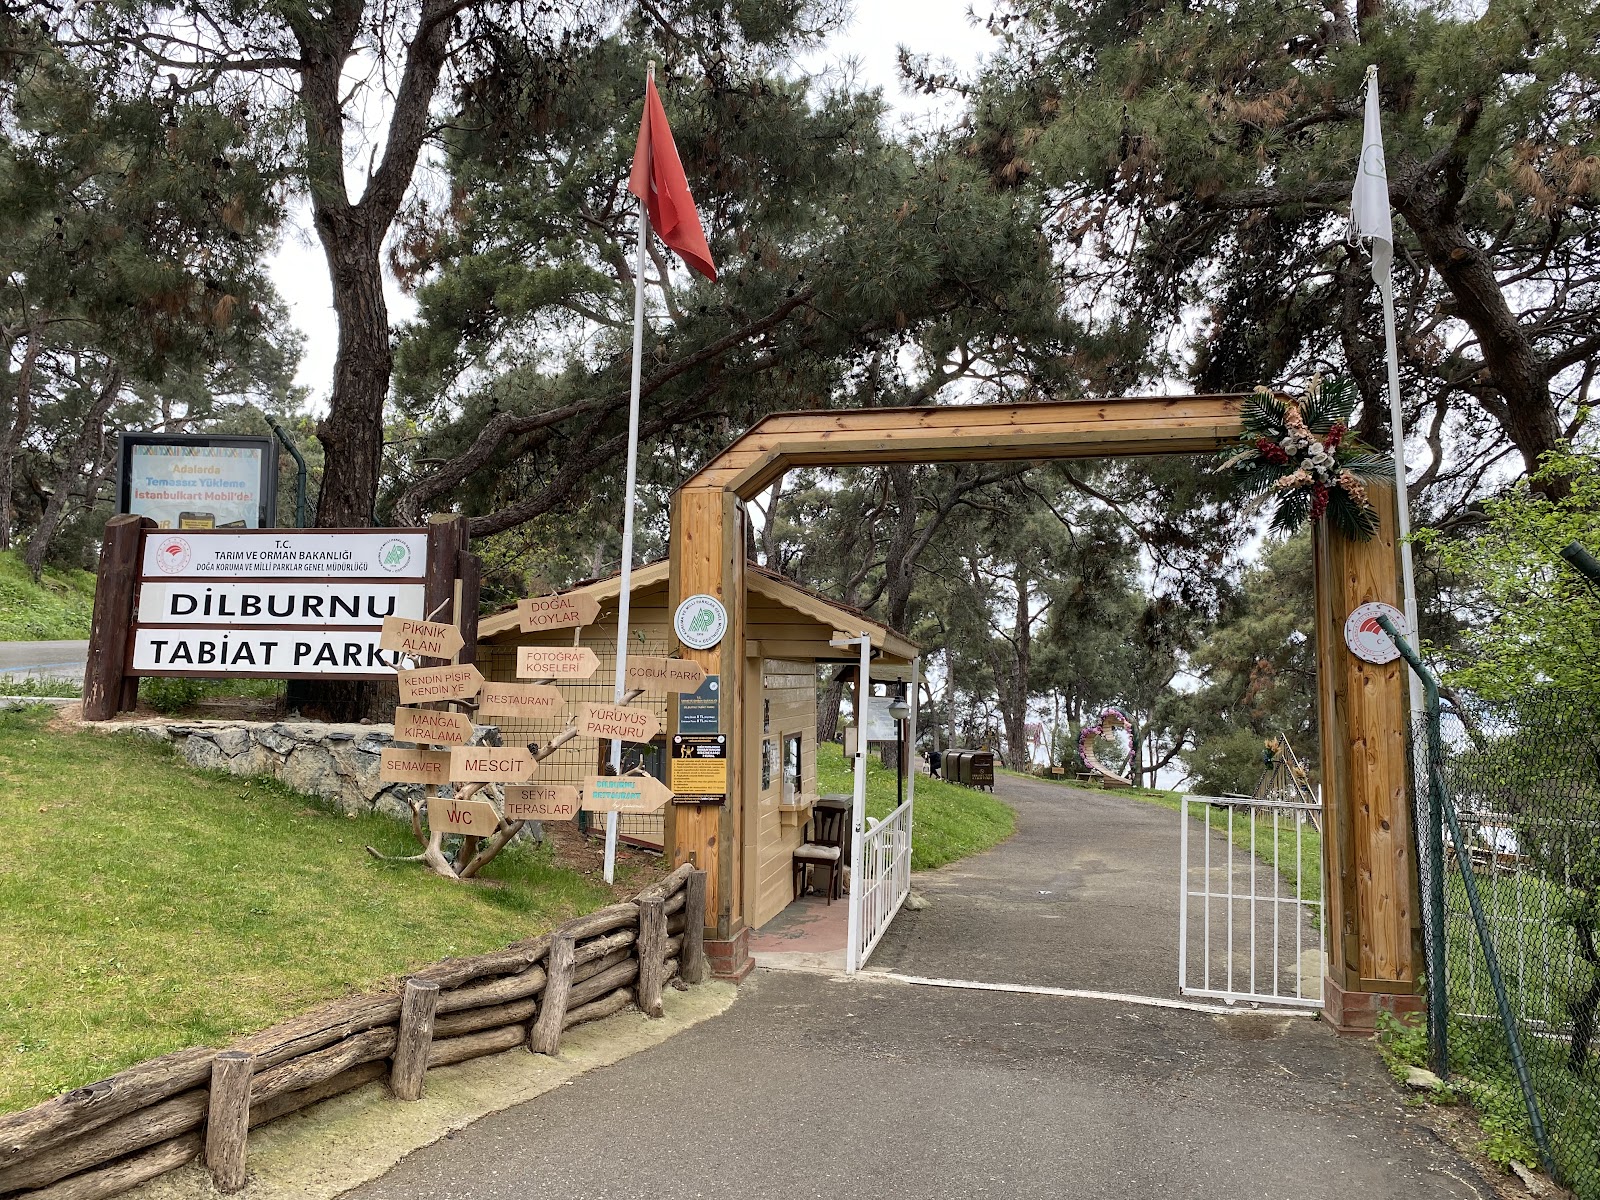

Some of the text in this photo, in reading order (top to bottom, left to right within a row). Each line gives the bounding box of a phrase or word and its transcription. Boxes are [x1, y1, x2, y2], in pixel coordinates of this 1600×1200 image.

[173, 465, 221, 474] Adalarda
[146, 477, 246, 488] Temassız Yükleme
[135, 488, 202, 500] İstanbulkart
[275, 540, 292, 549] T.C.
[215, 550, 352, 560] TARIM VE ORMAN BAKANLIĞI
[196, 562, 368, 571] DOĞA KORUMA VE MİLLİ PARKLAR GENEL MÜDÜRLÜĞÜ
[170, 587, 396, 618] DİLBURNU
[531, 598, 575, 612] DOĞAL
[529, 611, 580, 626] KOYLAR
[402, 621, 446, 639] PİKNİK
[150, 634, 278, 665] TABİAT
[402, 638, 441, 653] ALANI
[527, 652, 585, 661] FOTOĞRAF
[526, 663, 579, 674] KÖŞELERİ
[670, 670, 701, 681] PARKI
[411, 684, 465, 696] KENDİN YE
[486, 694, 555, 706] RESTAURANT
[412, 714, 460, 729] MANGAL
[589, 708, 647, 726] YÜRÜYÜŞ
[404, 727, 463, 743] KIRALAMA
[587, 723, 644, 738] PARKURU
[386, 760, 441, 772] SEMAVER
[465, 758, 524, 772] MESCİT
[521, 788, 556, 800] SEYİR
[508, 803, 573, 814] TERASLARI
[447, 809, 472, 825] WC
